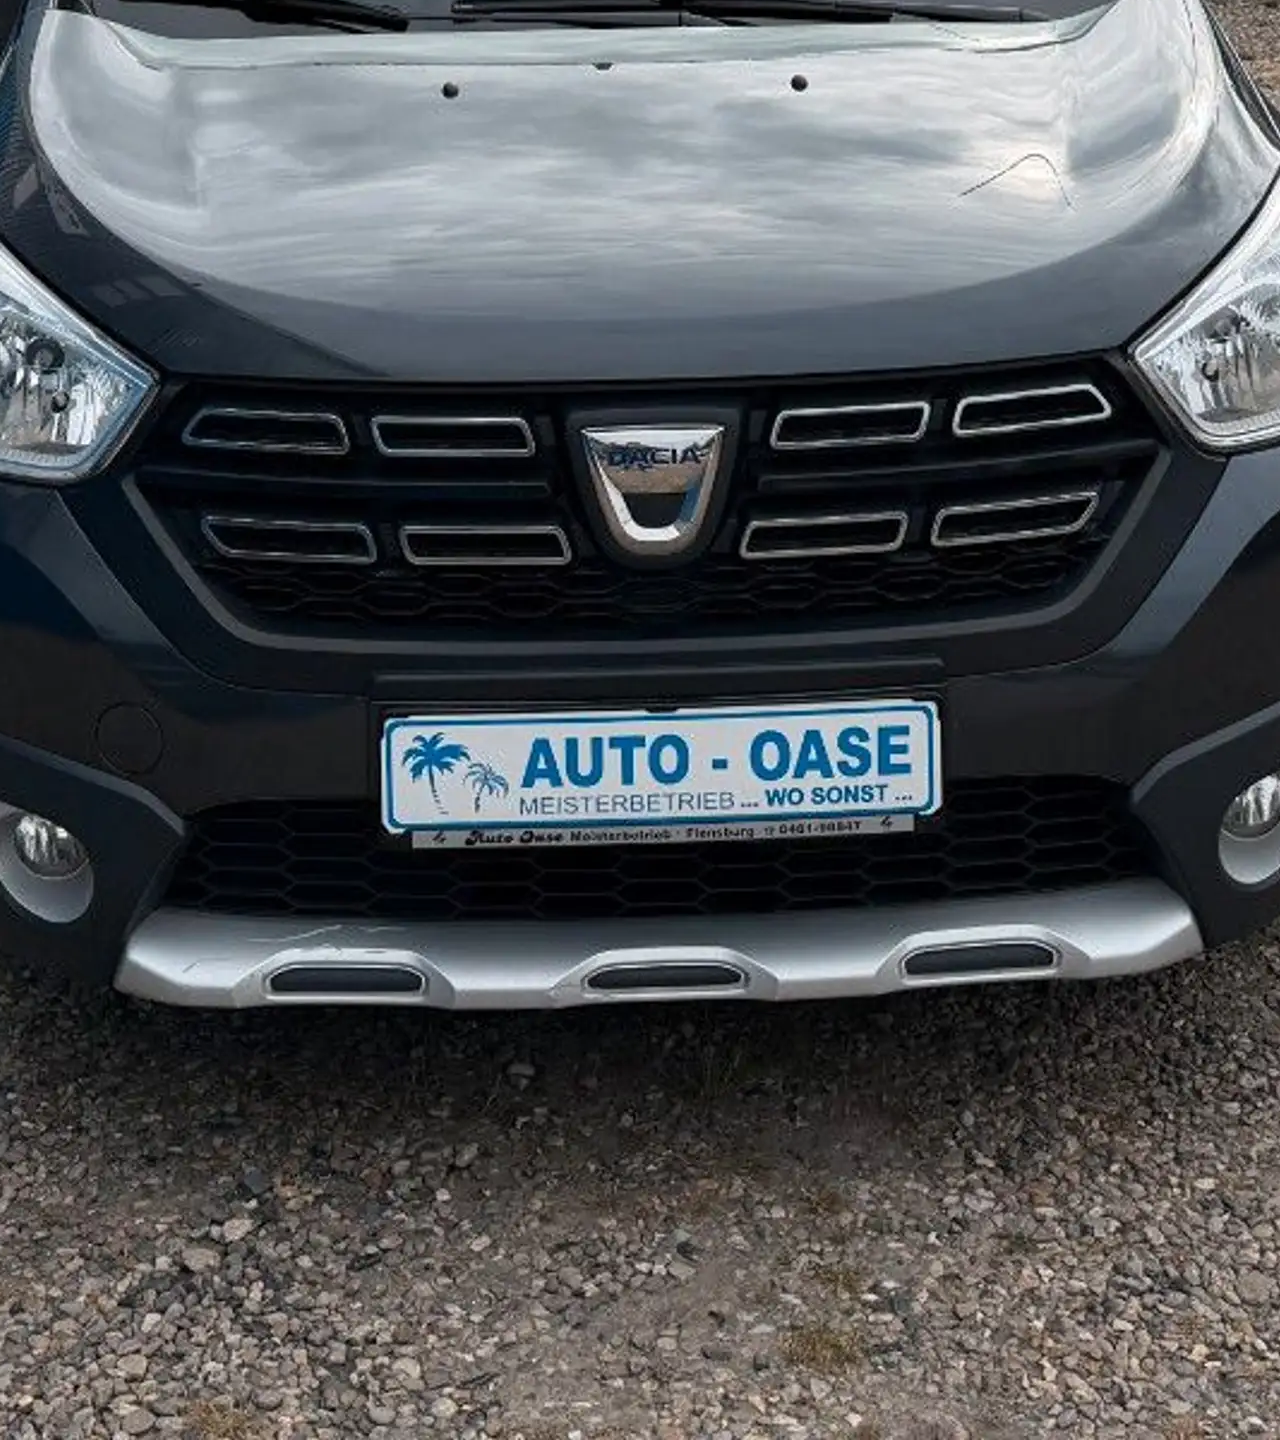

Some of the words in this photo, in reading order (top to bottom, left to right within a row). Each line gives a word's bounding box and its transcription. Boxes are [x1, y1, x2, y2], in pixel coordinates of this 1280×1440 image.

[608, 445, 702, 465] DACIA
[521, 734, 690, 788] AUTO
[750, 725, 912, 781] OASE
[520, 791, 734, 815] MEISTERBETRIEB
[765, 787, 804, 806] WO
[811, 785, 888, 804] SONST
